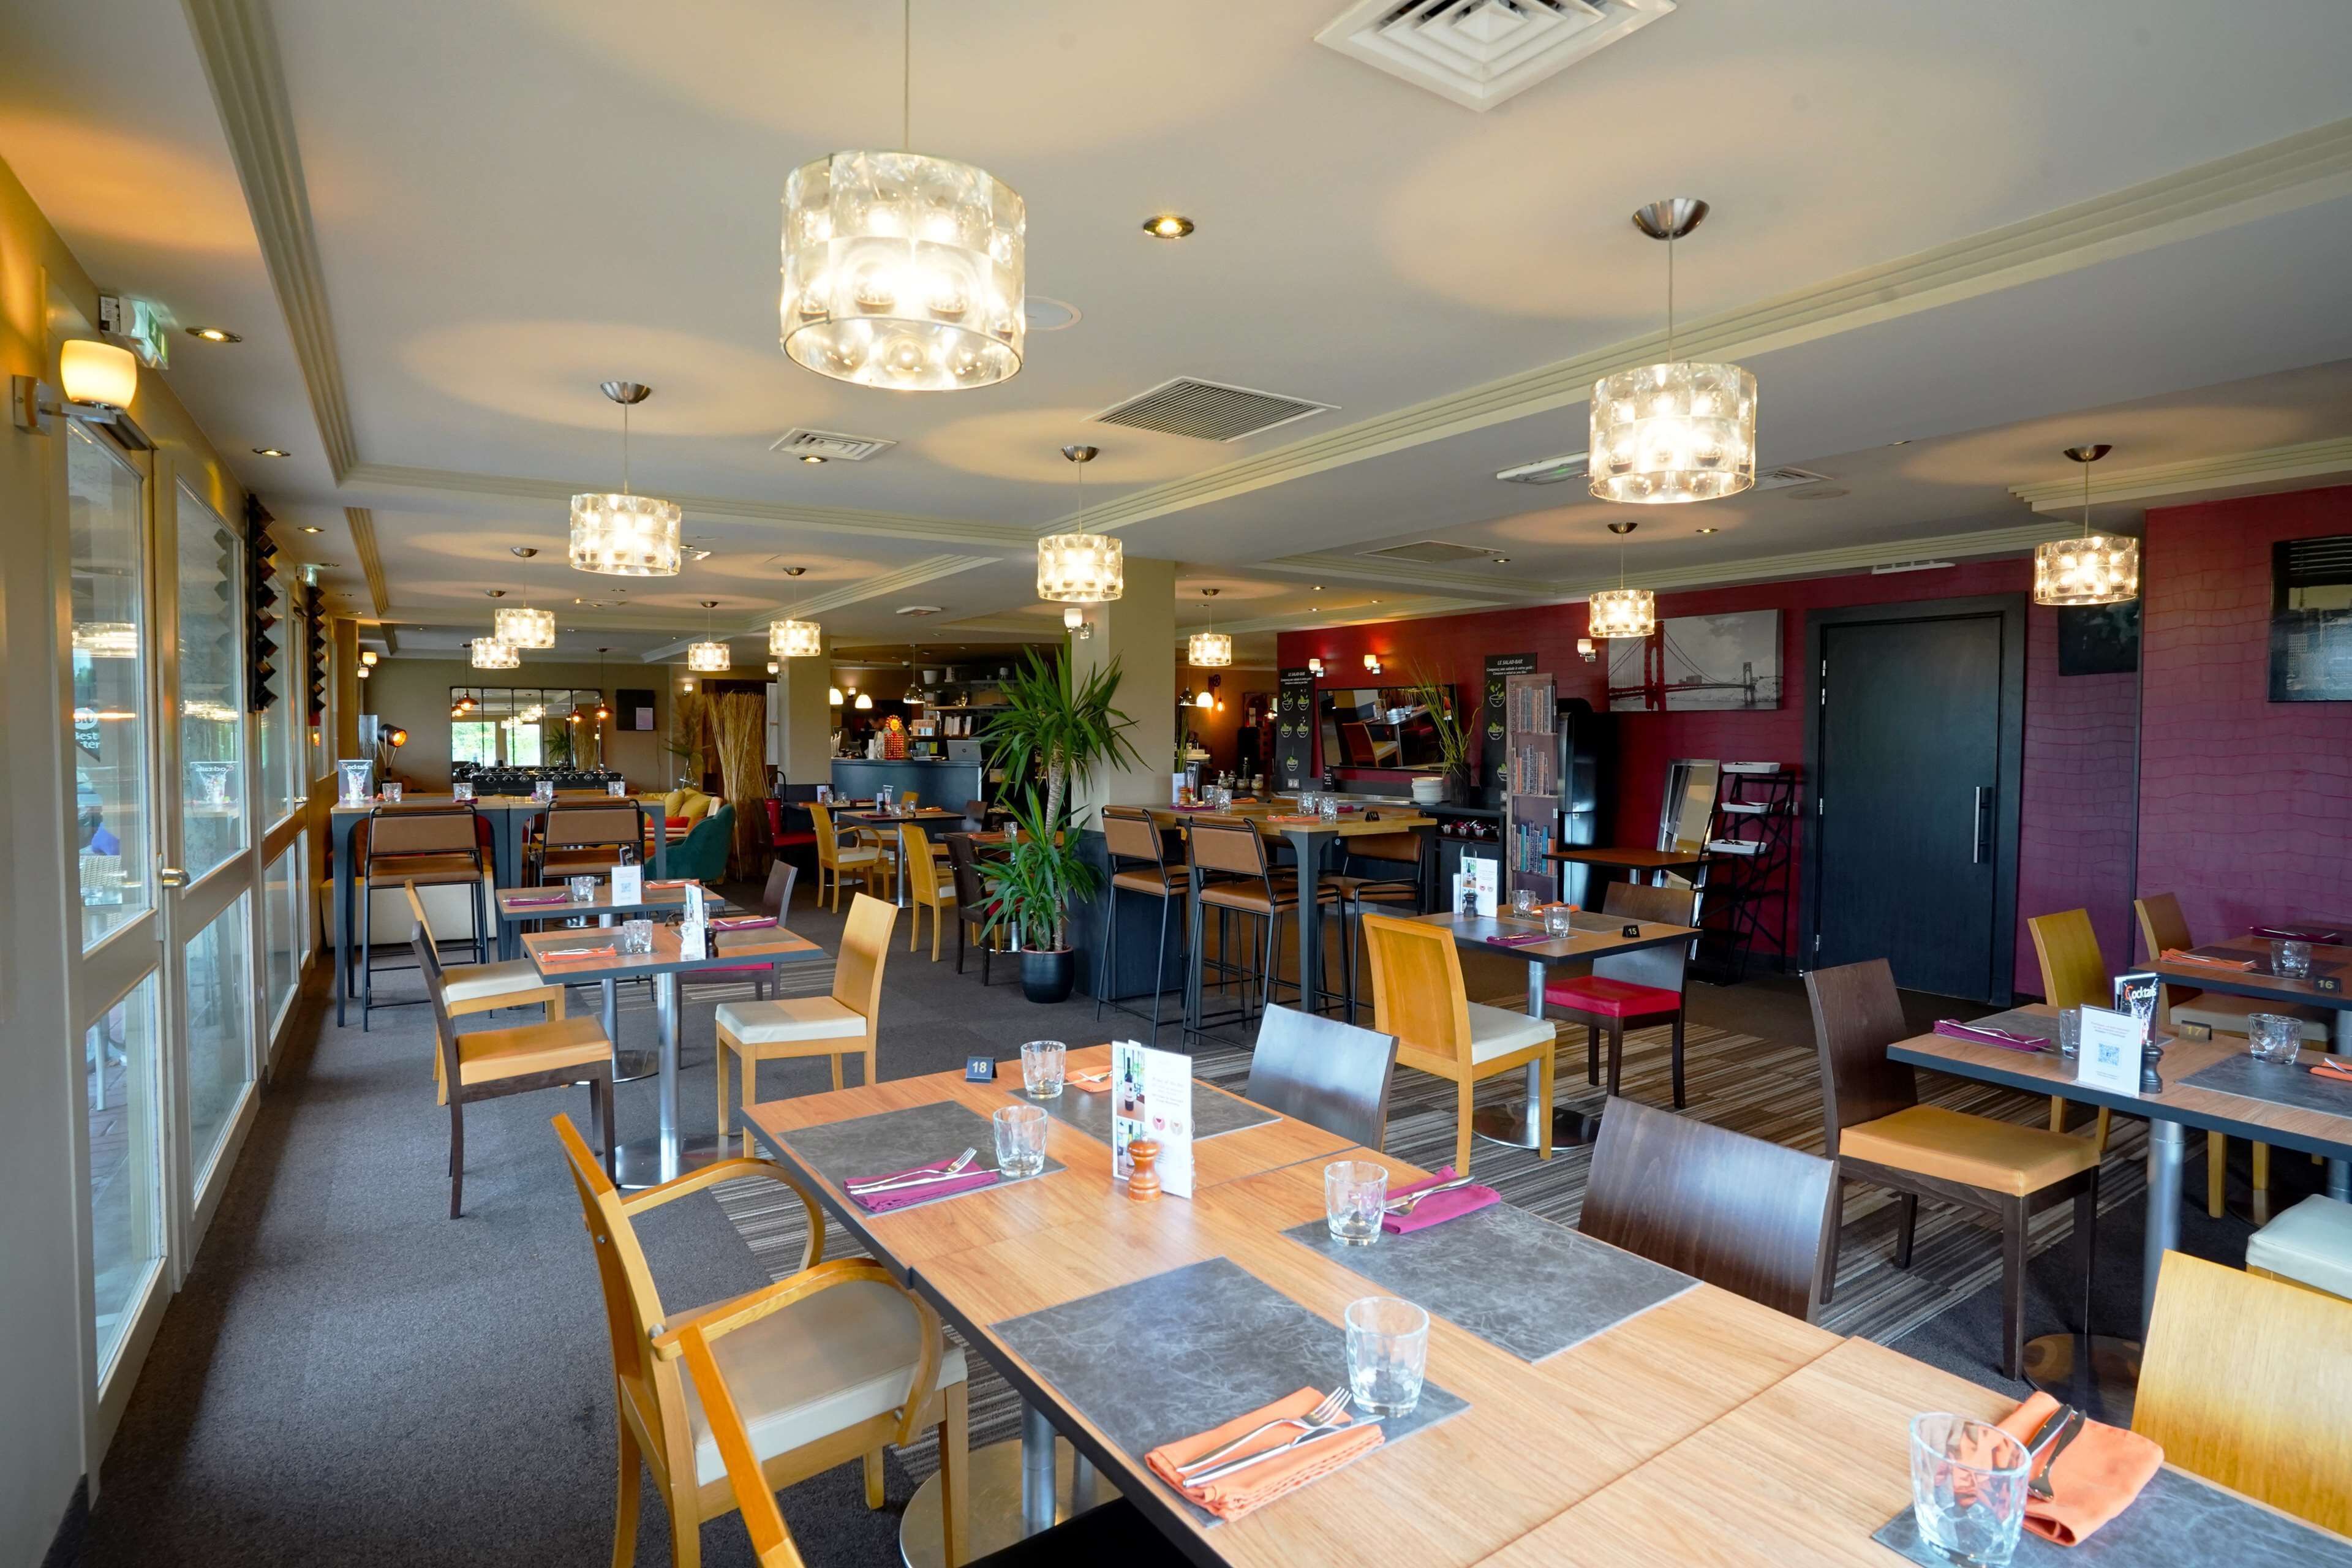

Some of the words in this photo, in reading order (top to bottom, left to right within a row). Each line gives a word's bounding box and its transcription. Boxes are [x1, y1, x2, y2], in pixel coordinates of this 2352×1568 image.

[2317, 980, 2334, 989] 16
[2124, 984, 2157, 1000] Cocktails
[2186, 1025, 2203, 1036] 17
[973, 1061, 987, 1073] 18
